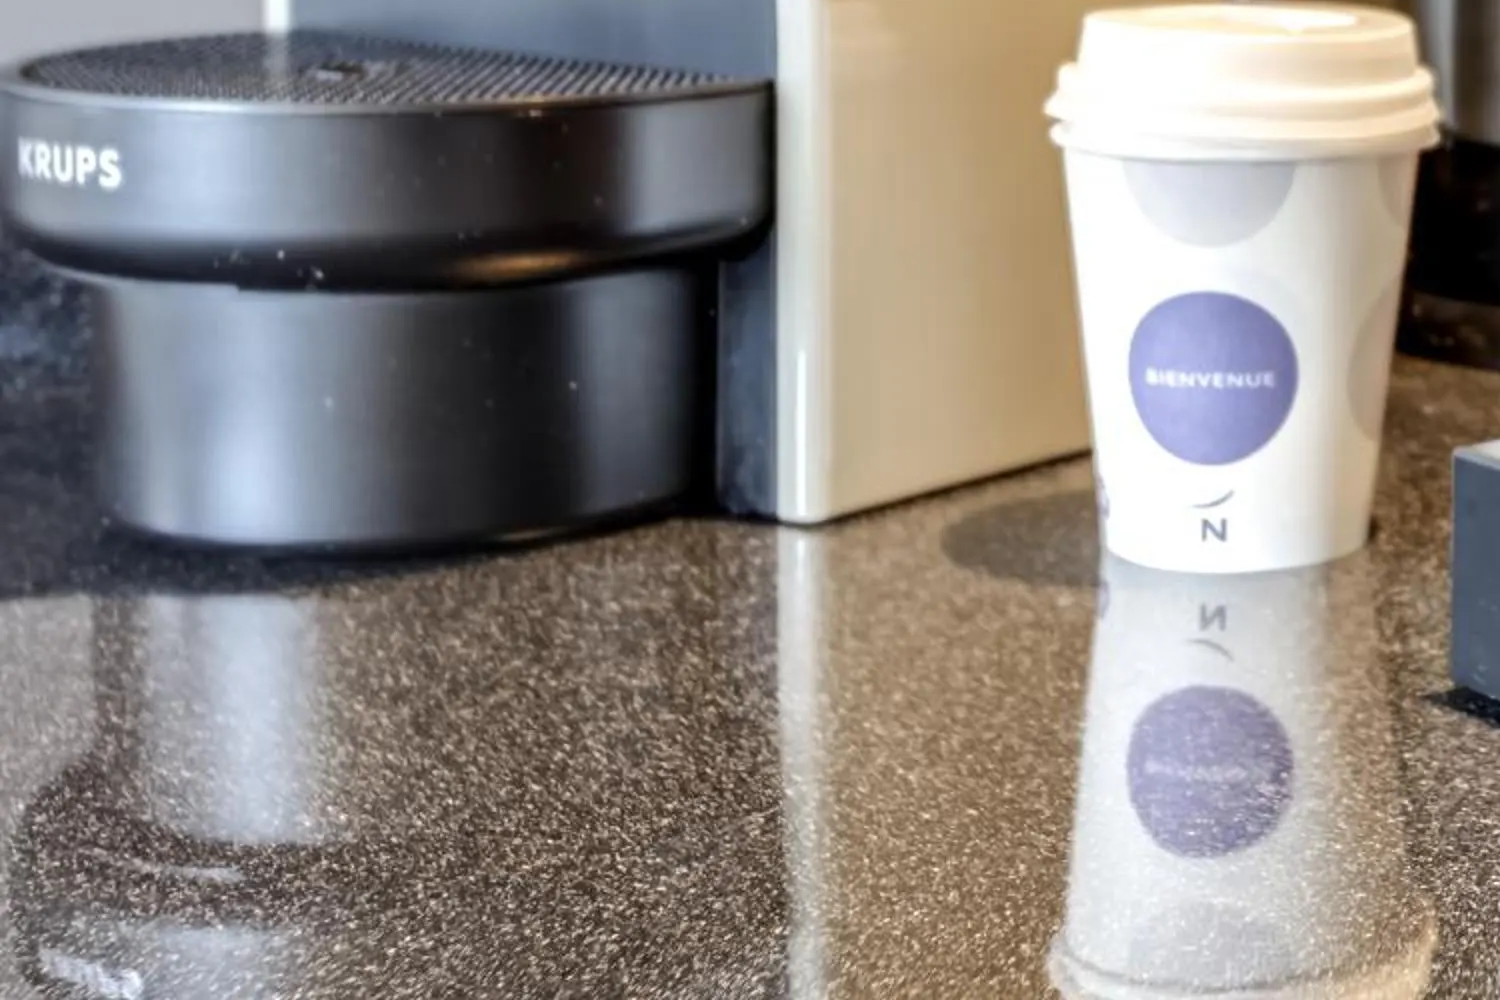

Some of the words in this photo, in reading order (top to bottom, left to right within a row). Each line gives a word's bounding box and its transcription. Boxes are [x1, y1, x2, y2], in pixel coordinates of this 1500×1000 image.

[17, 136, 122, 191] KRUPS
[1145, 368, 1275, 389] BIENVENUE
[1200, 517, 1228, 543] N
